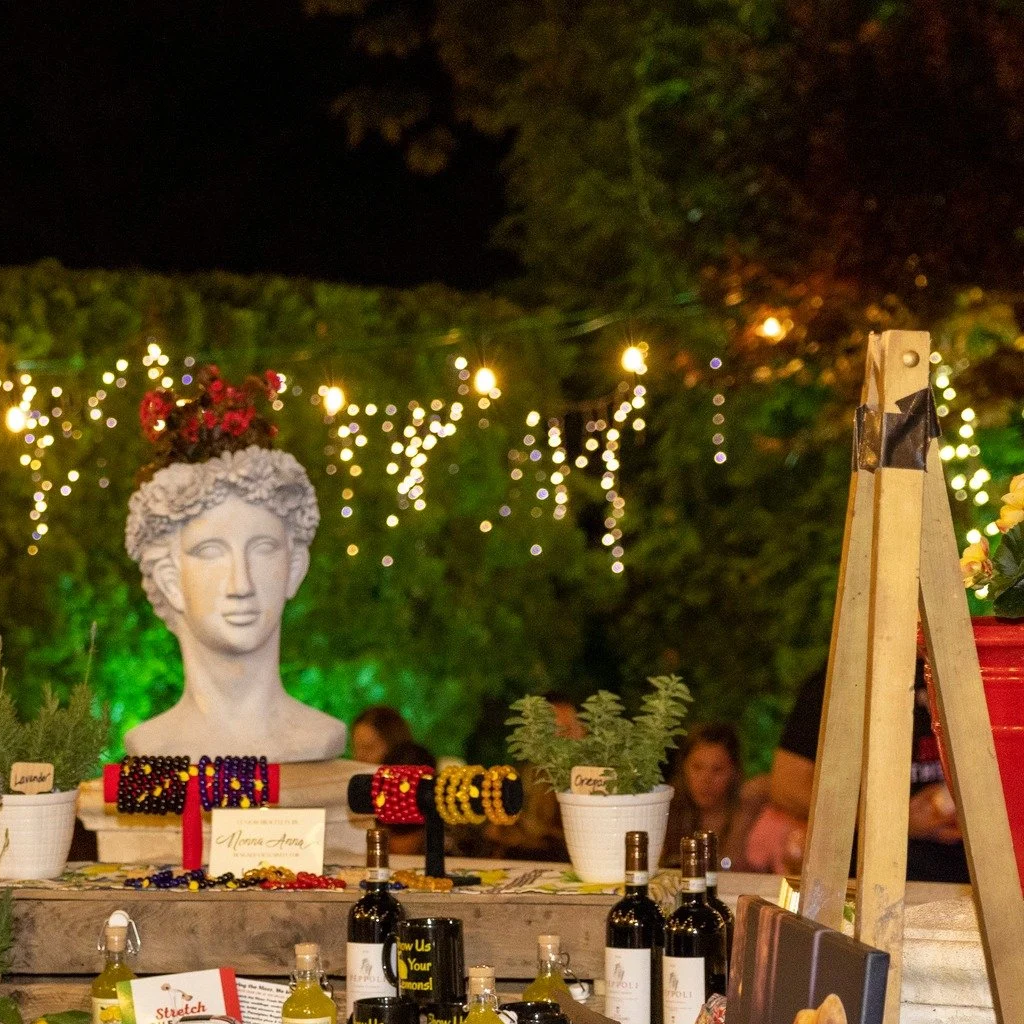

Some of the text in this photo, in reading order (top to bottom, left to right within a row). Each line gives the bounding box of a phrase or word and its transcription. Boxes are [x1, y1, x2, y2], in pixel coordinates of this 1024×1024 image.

[216, 829, 311, 851] Nonna Anna
[415, 938, 432, 952] Us
[407, 957, 432, 972] Your
[156, 1001, 207, 1020] Stretch
